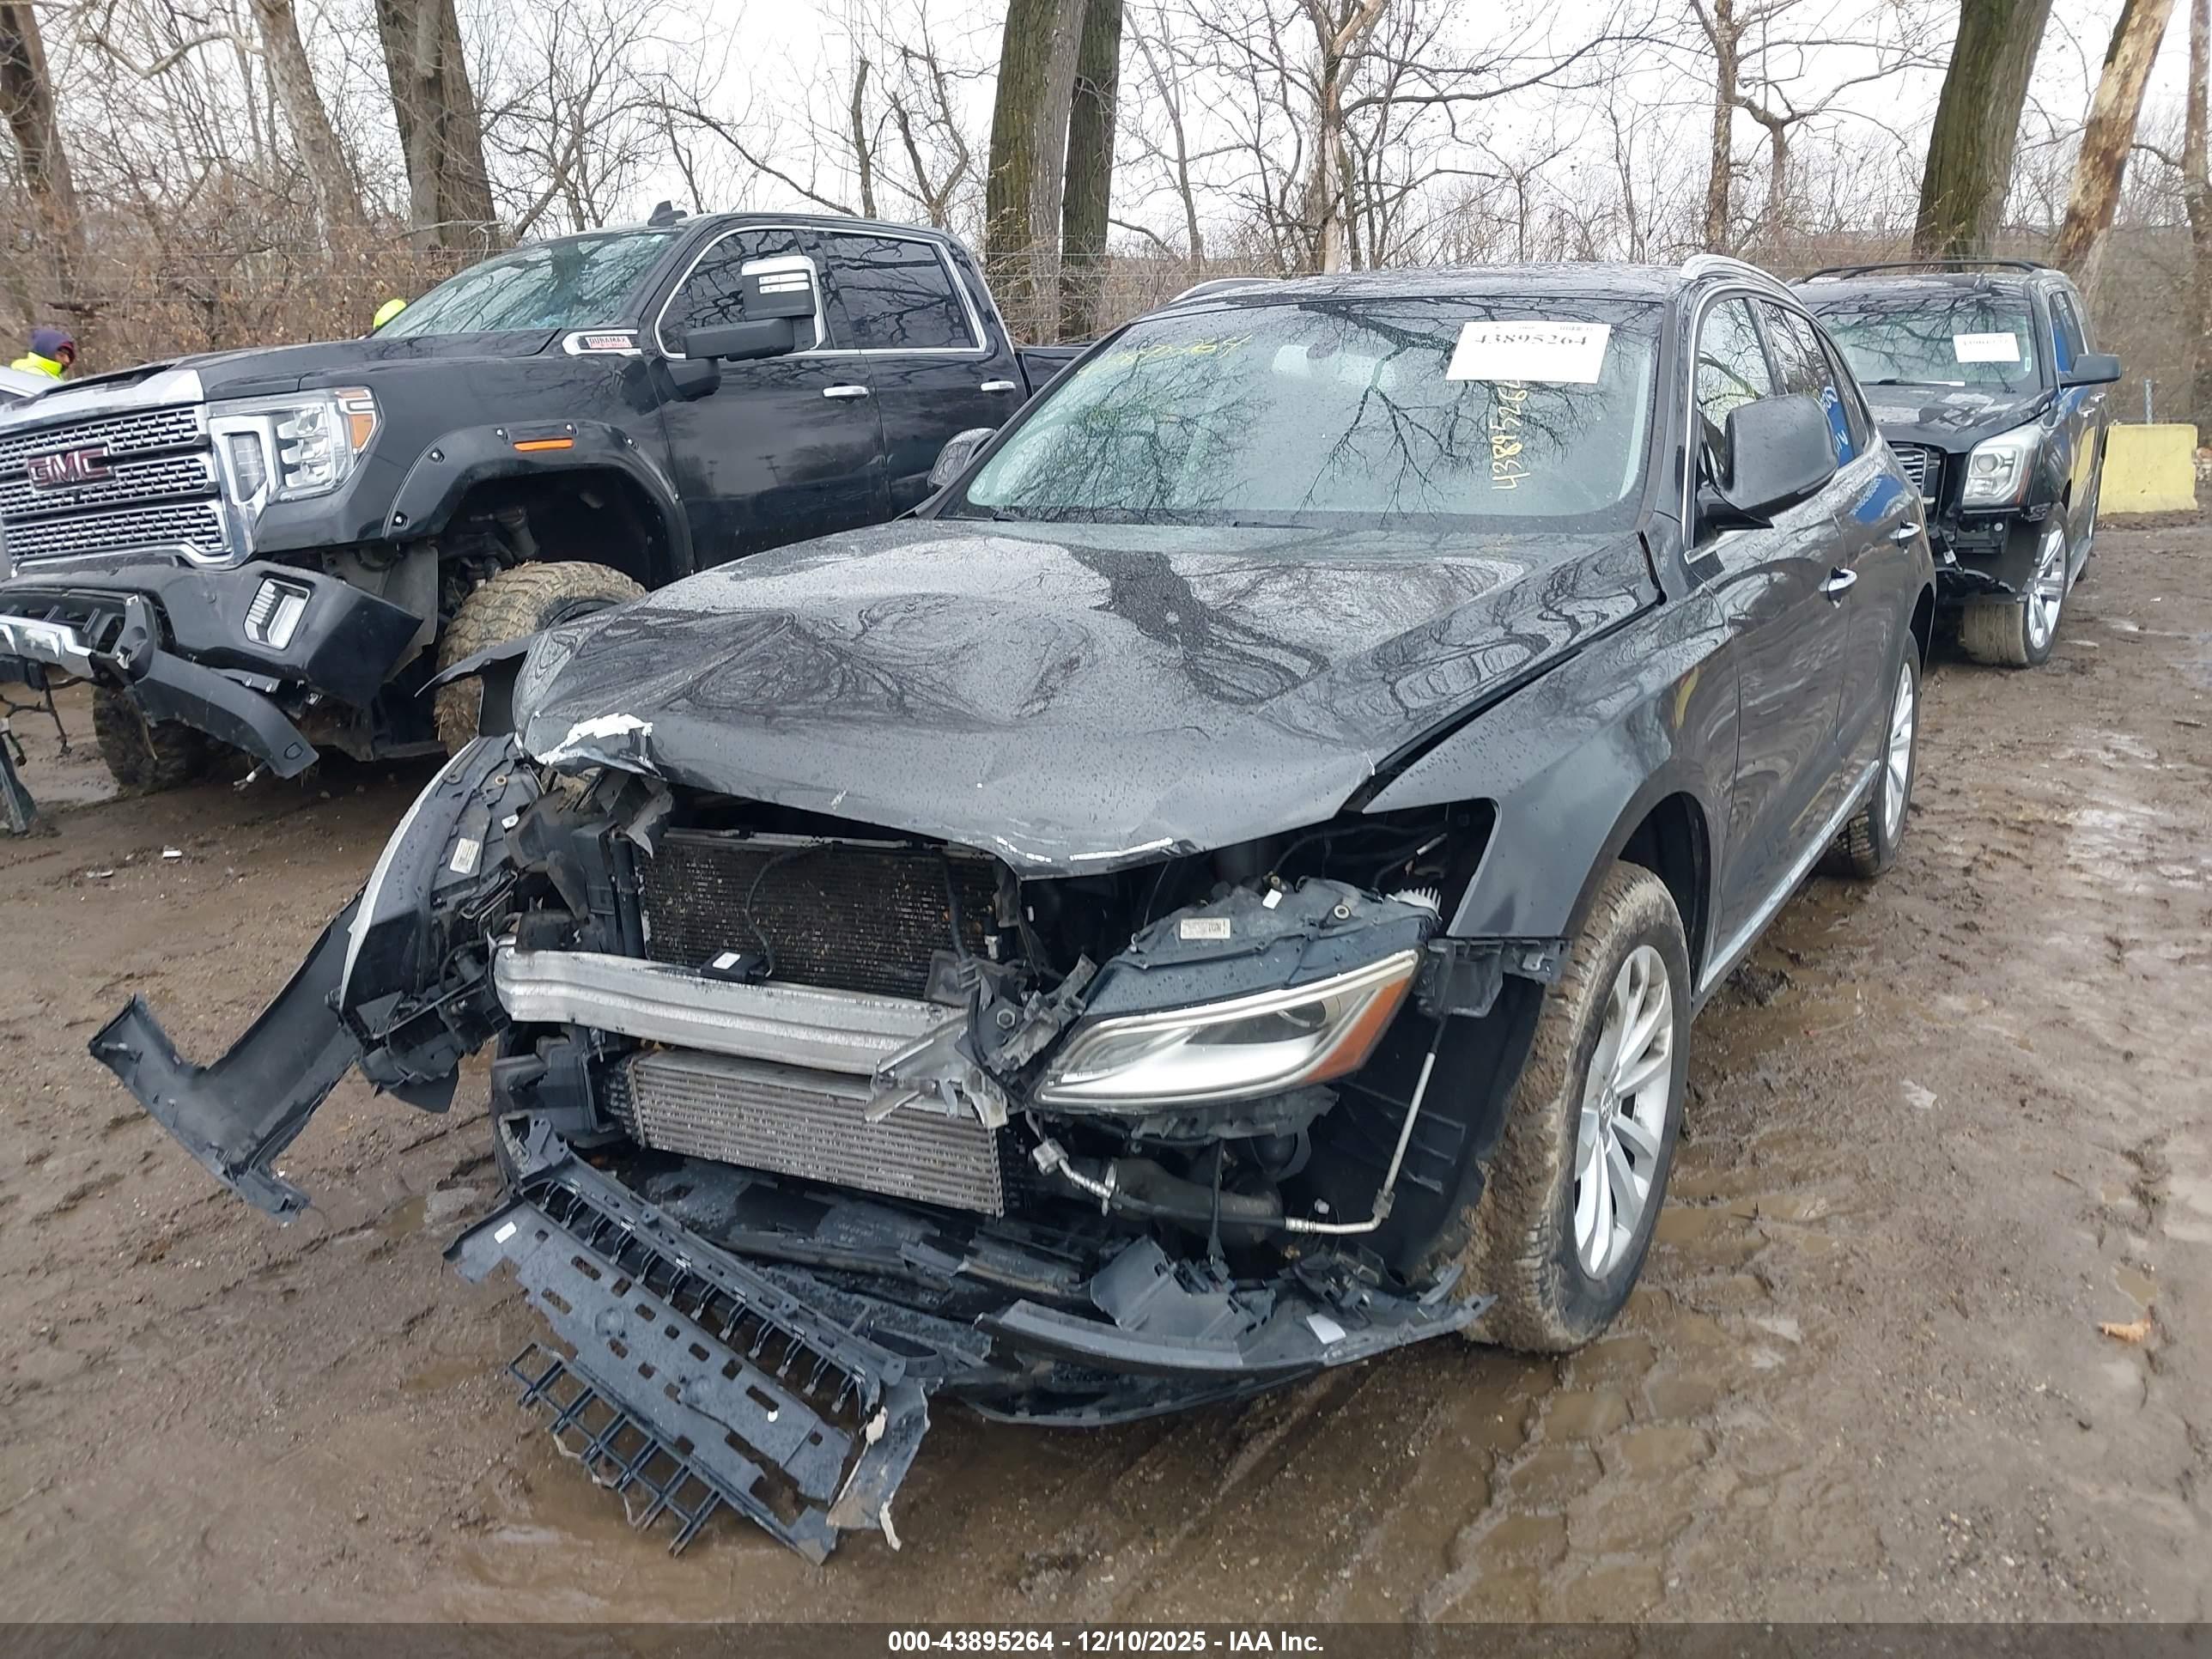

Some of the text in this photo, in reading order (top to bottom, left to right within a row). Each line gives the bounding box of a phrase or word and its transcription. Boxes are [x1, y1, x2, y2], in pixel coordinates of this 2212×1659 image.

[588, 336, 627, 344] DURAMAX
[1474, 334, 1587, 346] 43895264
[27, 447, 111, 487] GMC
